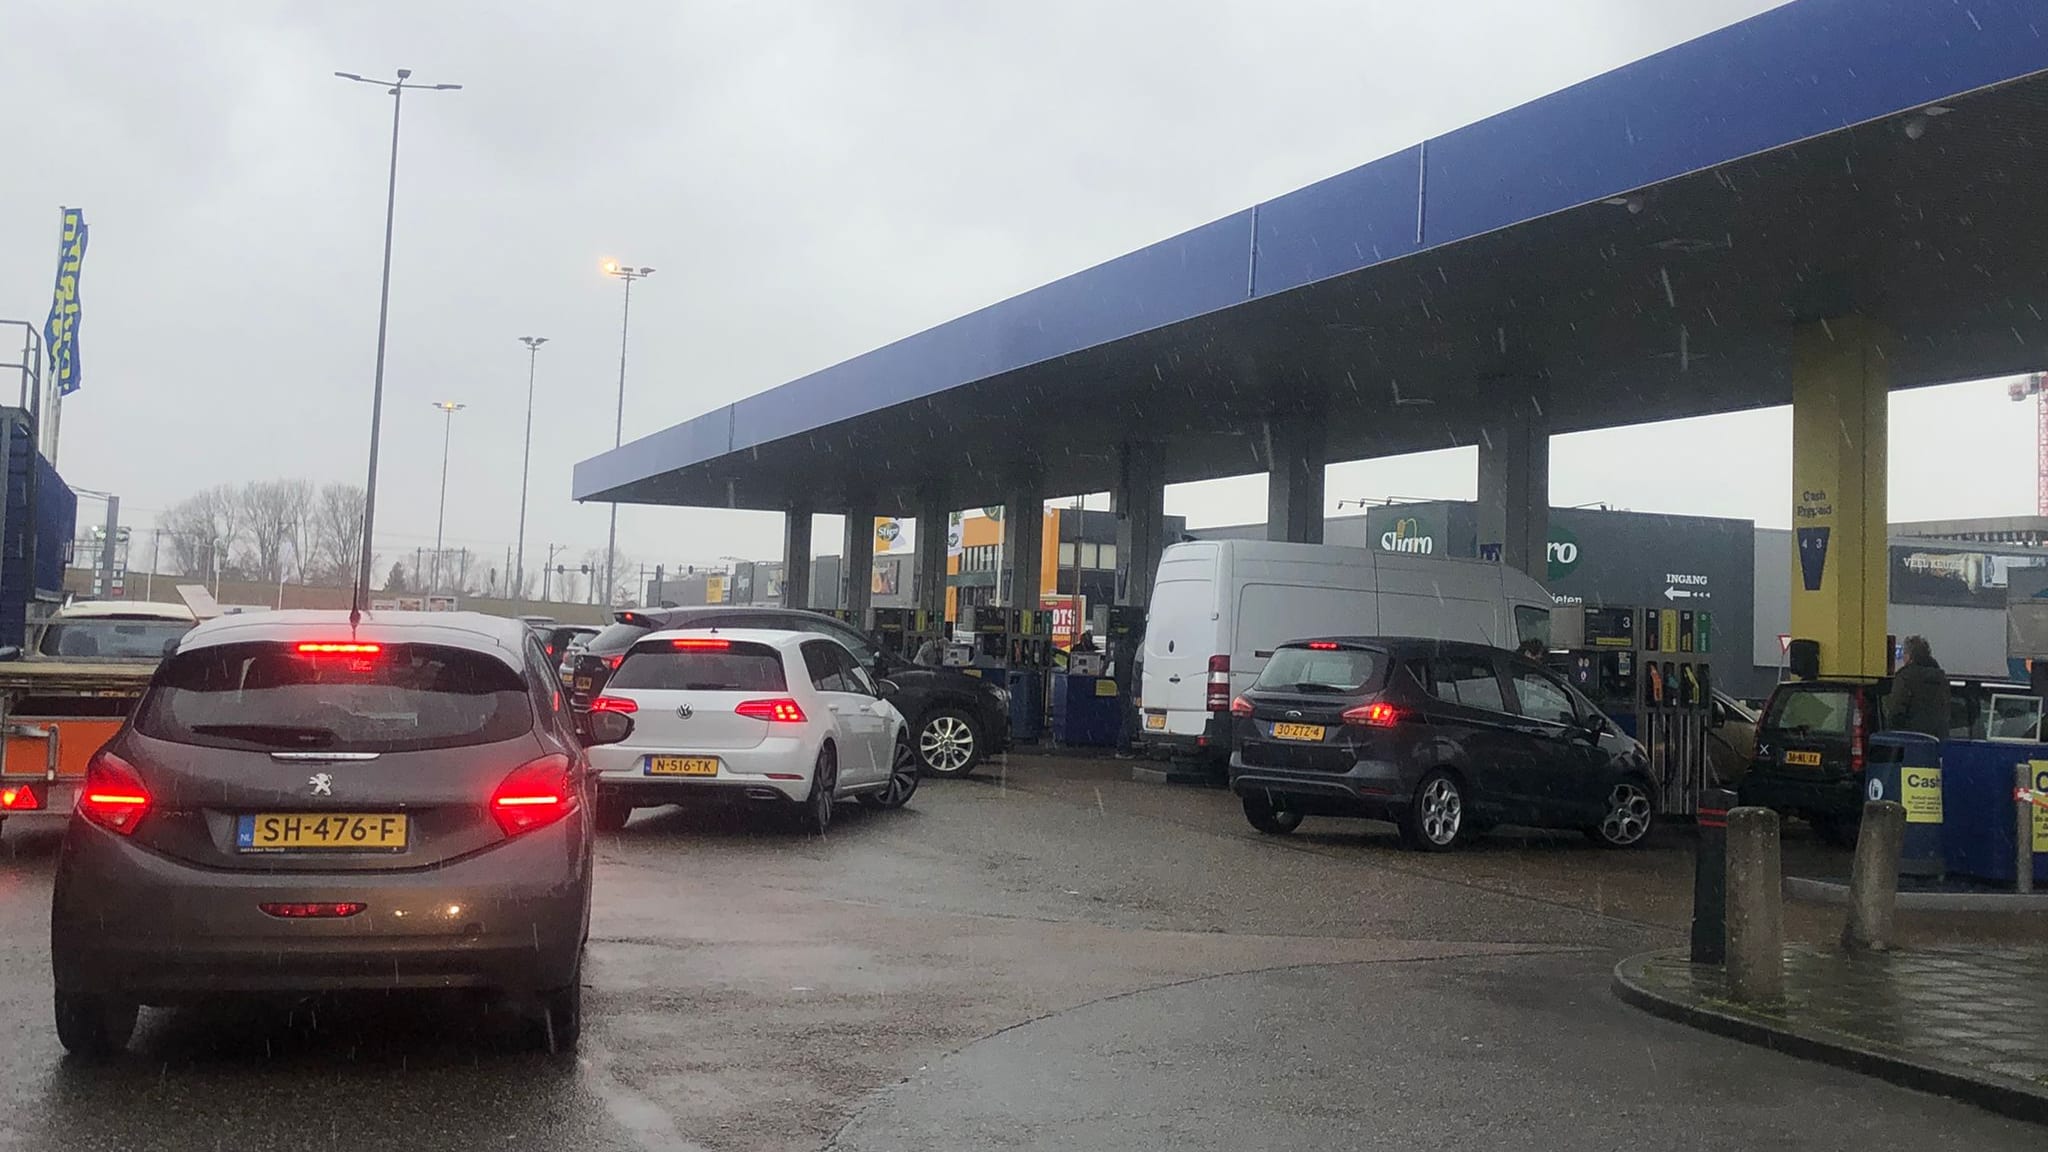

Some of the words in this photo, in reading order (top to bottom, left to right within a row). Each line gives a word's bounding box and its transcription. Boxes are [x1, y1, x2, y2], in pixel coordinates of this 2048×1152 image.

[1802, 490, 1827, 502] Cash
[1815, 538, 1823, 549] 3
[1666, 574, 1708, 585] INGANG
[1622, 616, 1632, 629] 3
[1276, 724, 1320, 737] 30-ZTZ-4
[656, 759, 711, 772] N-516-TK
[263, 817, 397, 842] SH-476-F
